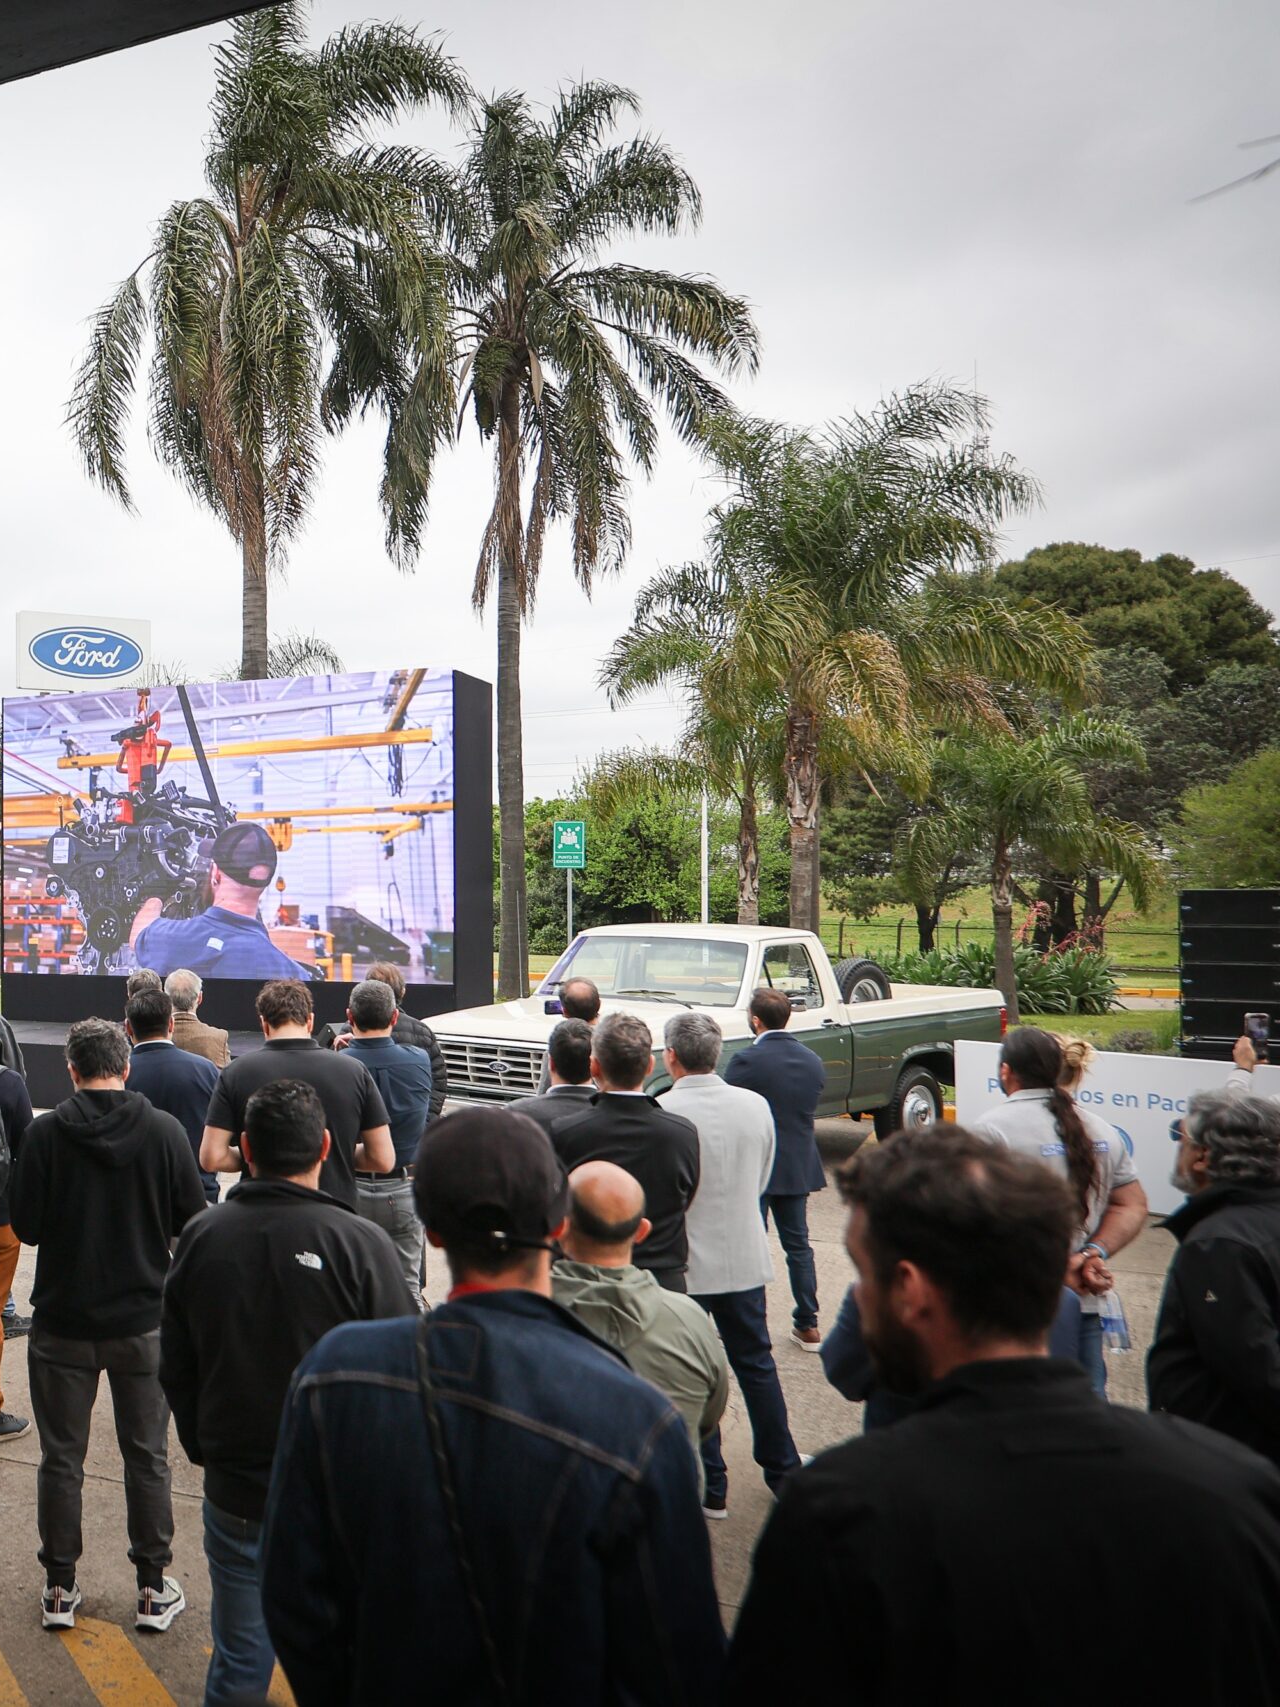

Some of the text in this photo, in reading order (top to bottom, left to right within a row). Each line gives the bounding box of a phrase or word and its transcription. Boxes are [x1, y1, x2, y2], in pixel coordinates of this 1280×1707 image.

[54, 633, 123, 668] Ford
[1111, 1092, 1187, 1113] en Pac
